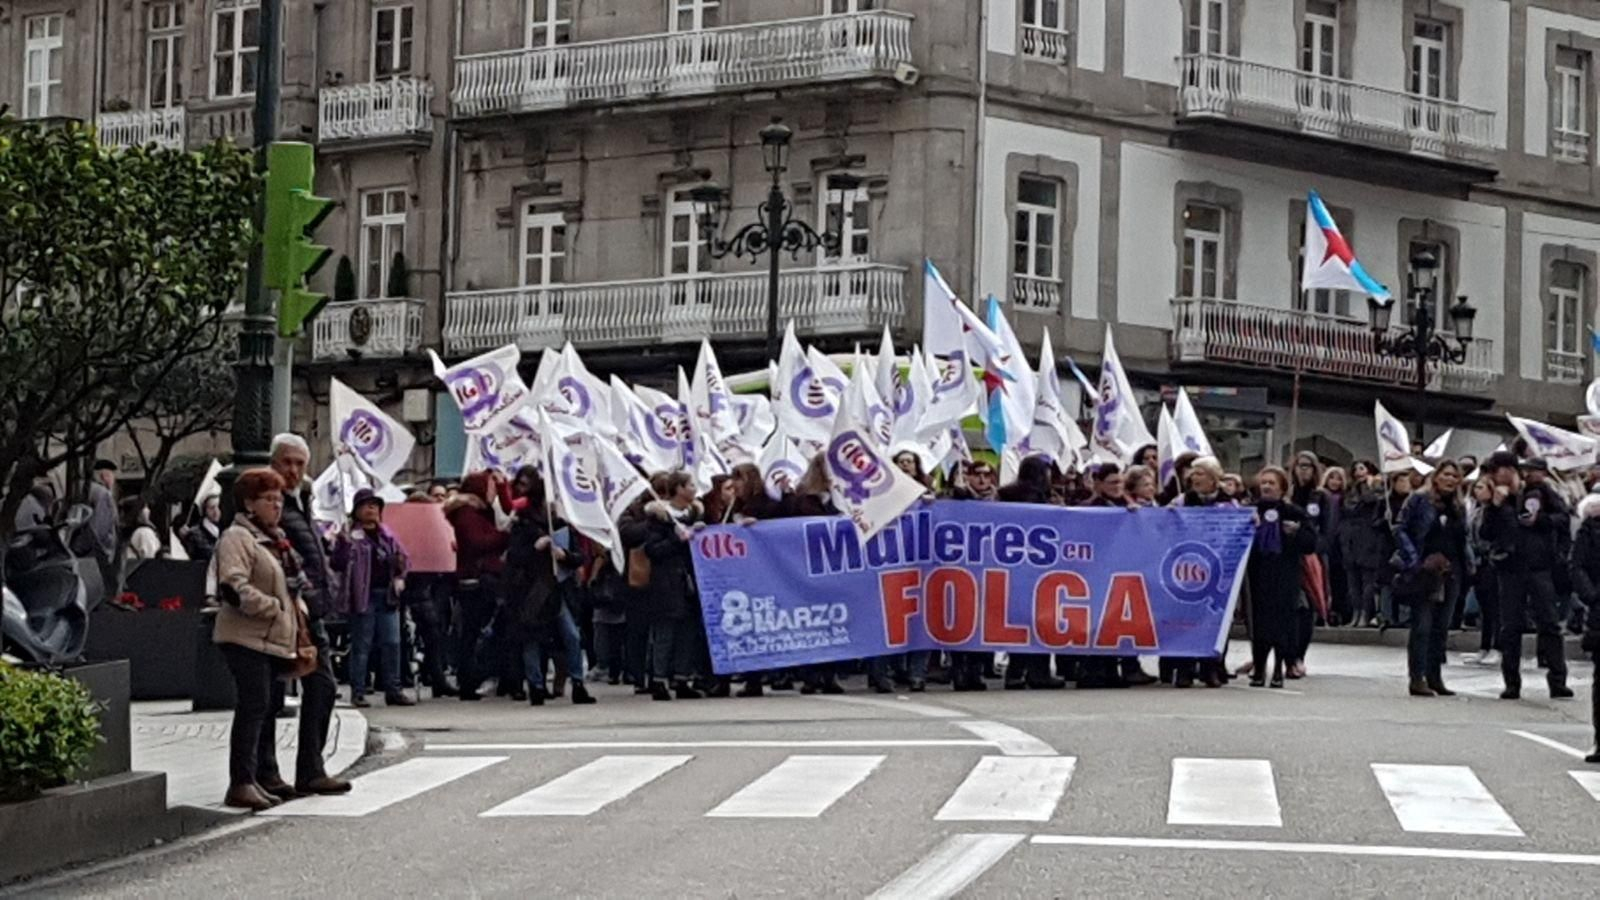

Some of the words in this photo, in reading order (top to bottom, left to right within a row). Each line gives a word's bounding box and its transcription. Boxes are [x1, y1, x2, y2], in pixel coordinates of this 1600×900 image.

[803, 512, 1061, 577] Mulleres
[1062, 541, 1093, 562] en
[721, 590, 754, 636] 8
[752, 596, 777, 612] DE
[879, 565, 1159, 650] FOLGA
